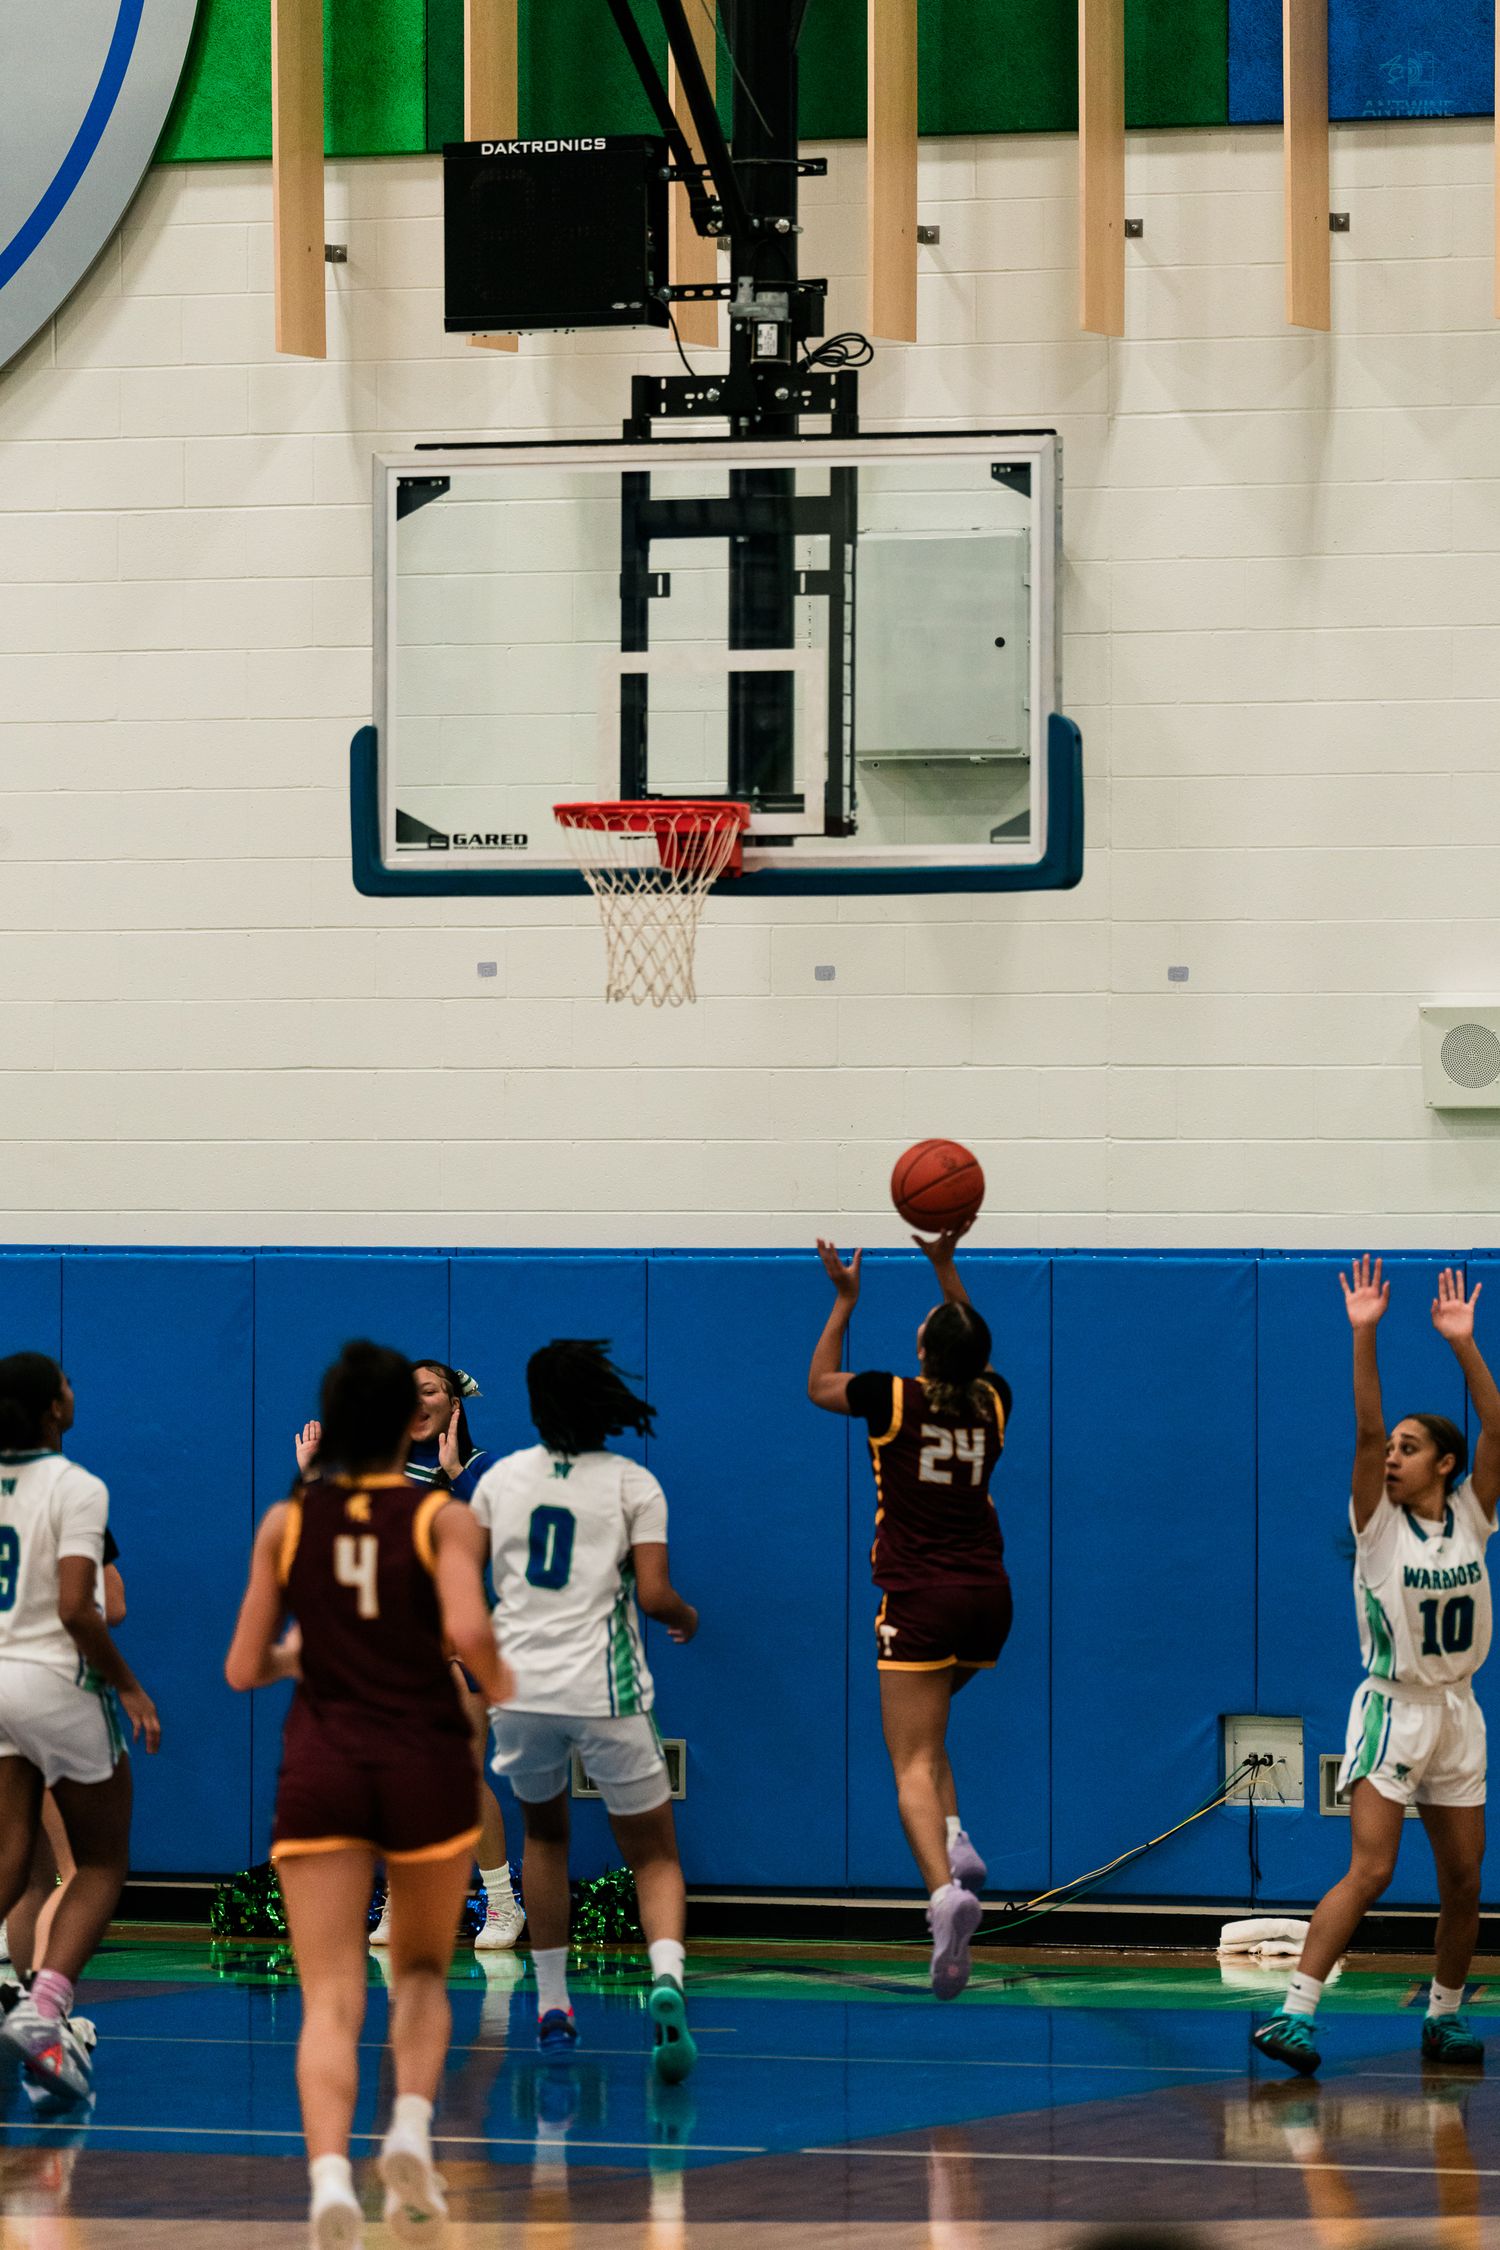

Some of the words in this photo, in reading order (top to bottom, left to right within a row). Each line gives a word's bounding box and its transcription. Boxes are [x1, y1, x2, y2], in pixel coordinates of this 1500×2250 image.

[481, 138, 607, 155] DAKTRONICS
[453, 834, 528, 846] GARED
[918, 1423, 985, 1487] 24
[334, 1533, 380, 1620] 4
[525, 1504, 577, 1592] 0
[1419, 1595, 1475, 1657] 10
